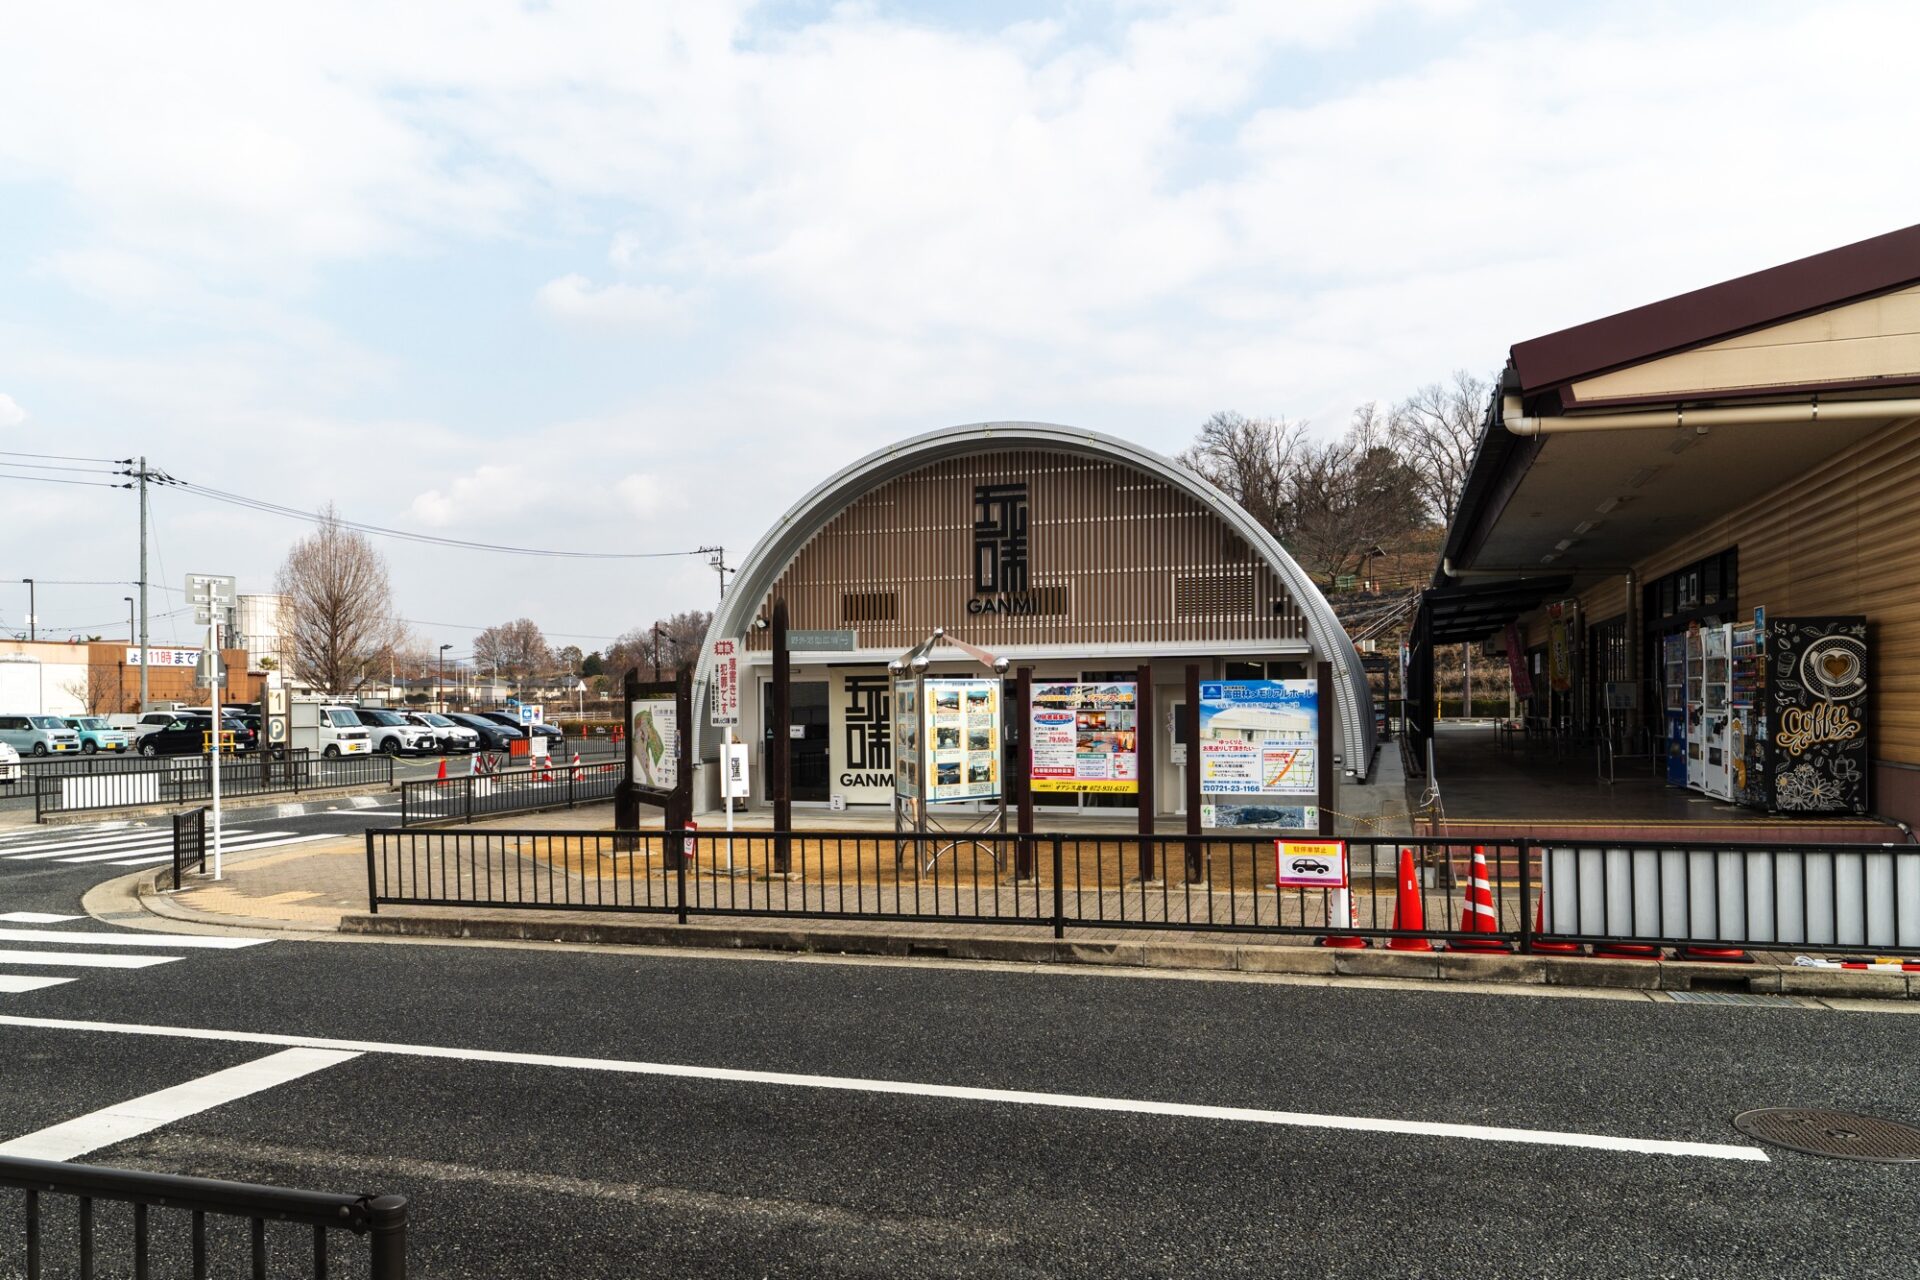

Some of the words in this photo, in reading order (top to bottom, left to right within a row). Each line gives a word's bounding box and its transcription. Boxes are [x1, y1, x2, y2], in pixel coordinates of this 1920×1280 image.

[967, 598, 1037, 614] GANMI
[275, 692, 281, 711] 1
[1223, 688, 1314, 699] 富田林メモリアルホール
[272, 721, 282, 738] P
[1778, 702, 1859, 750] Coffee
[839, 773, 895, 787] GANM
